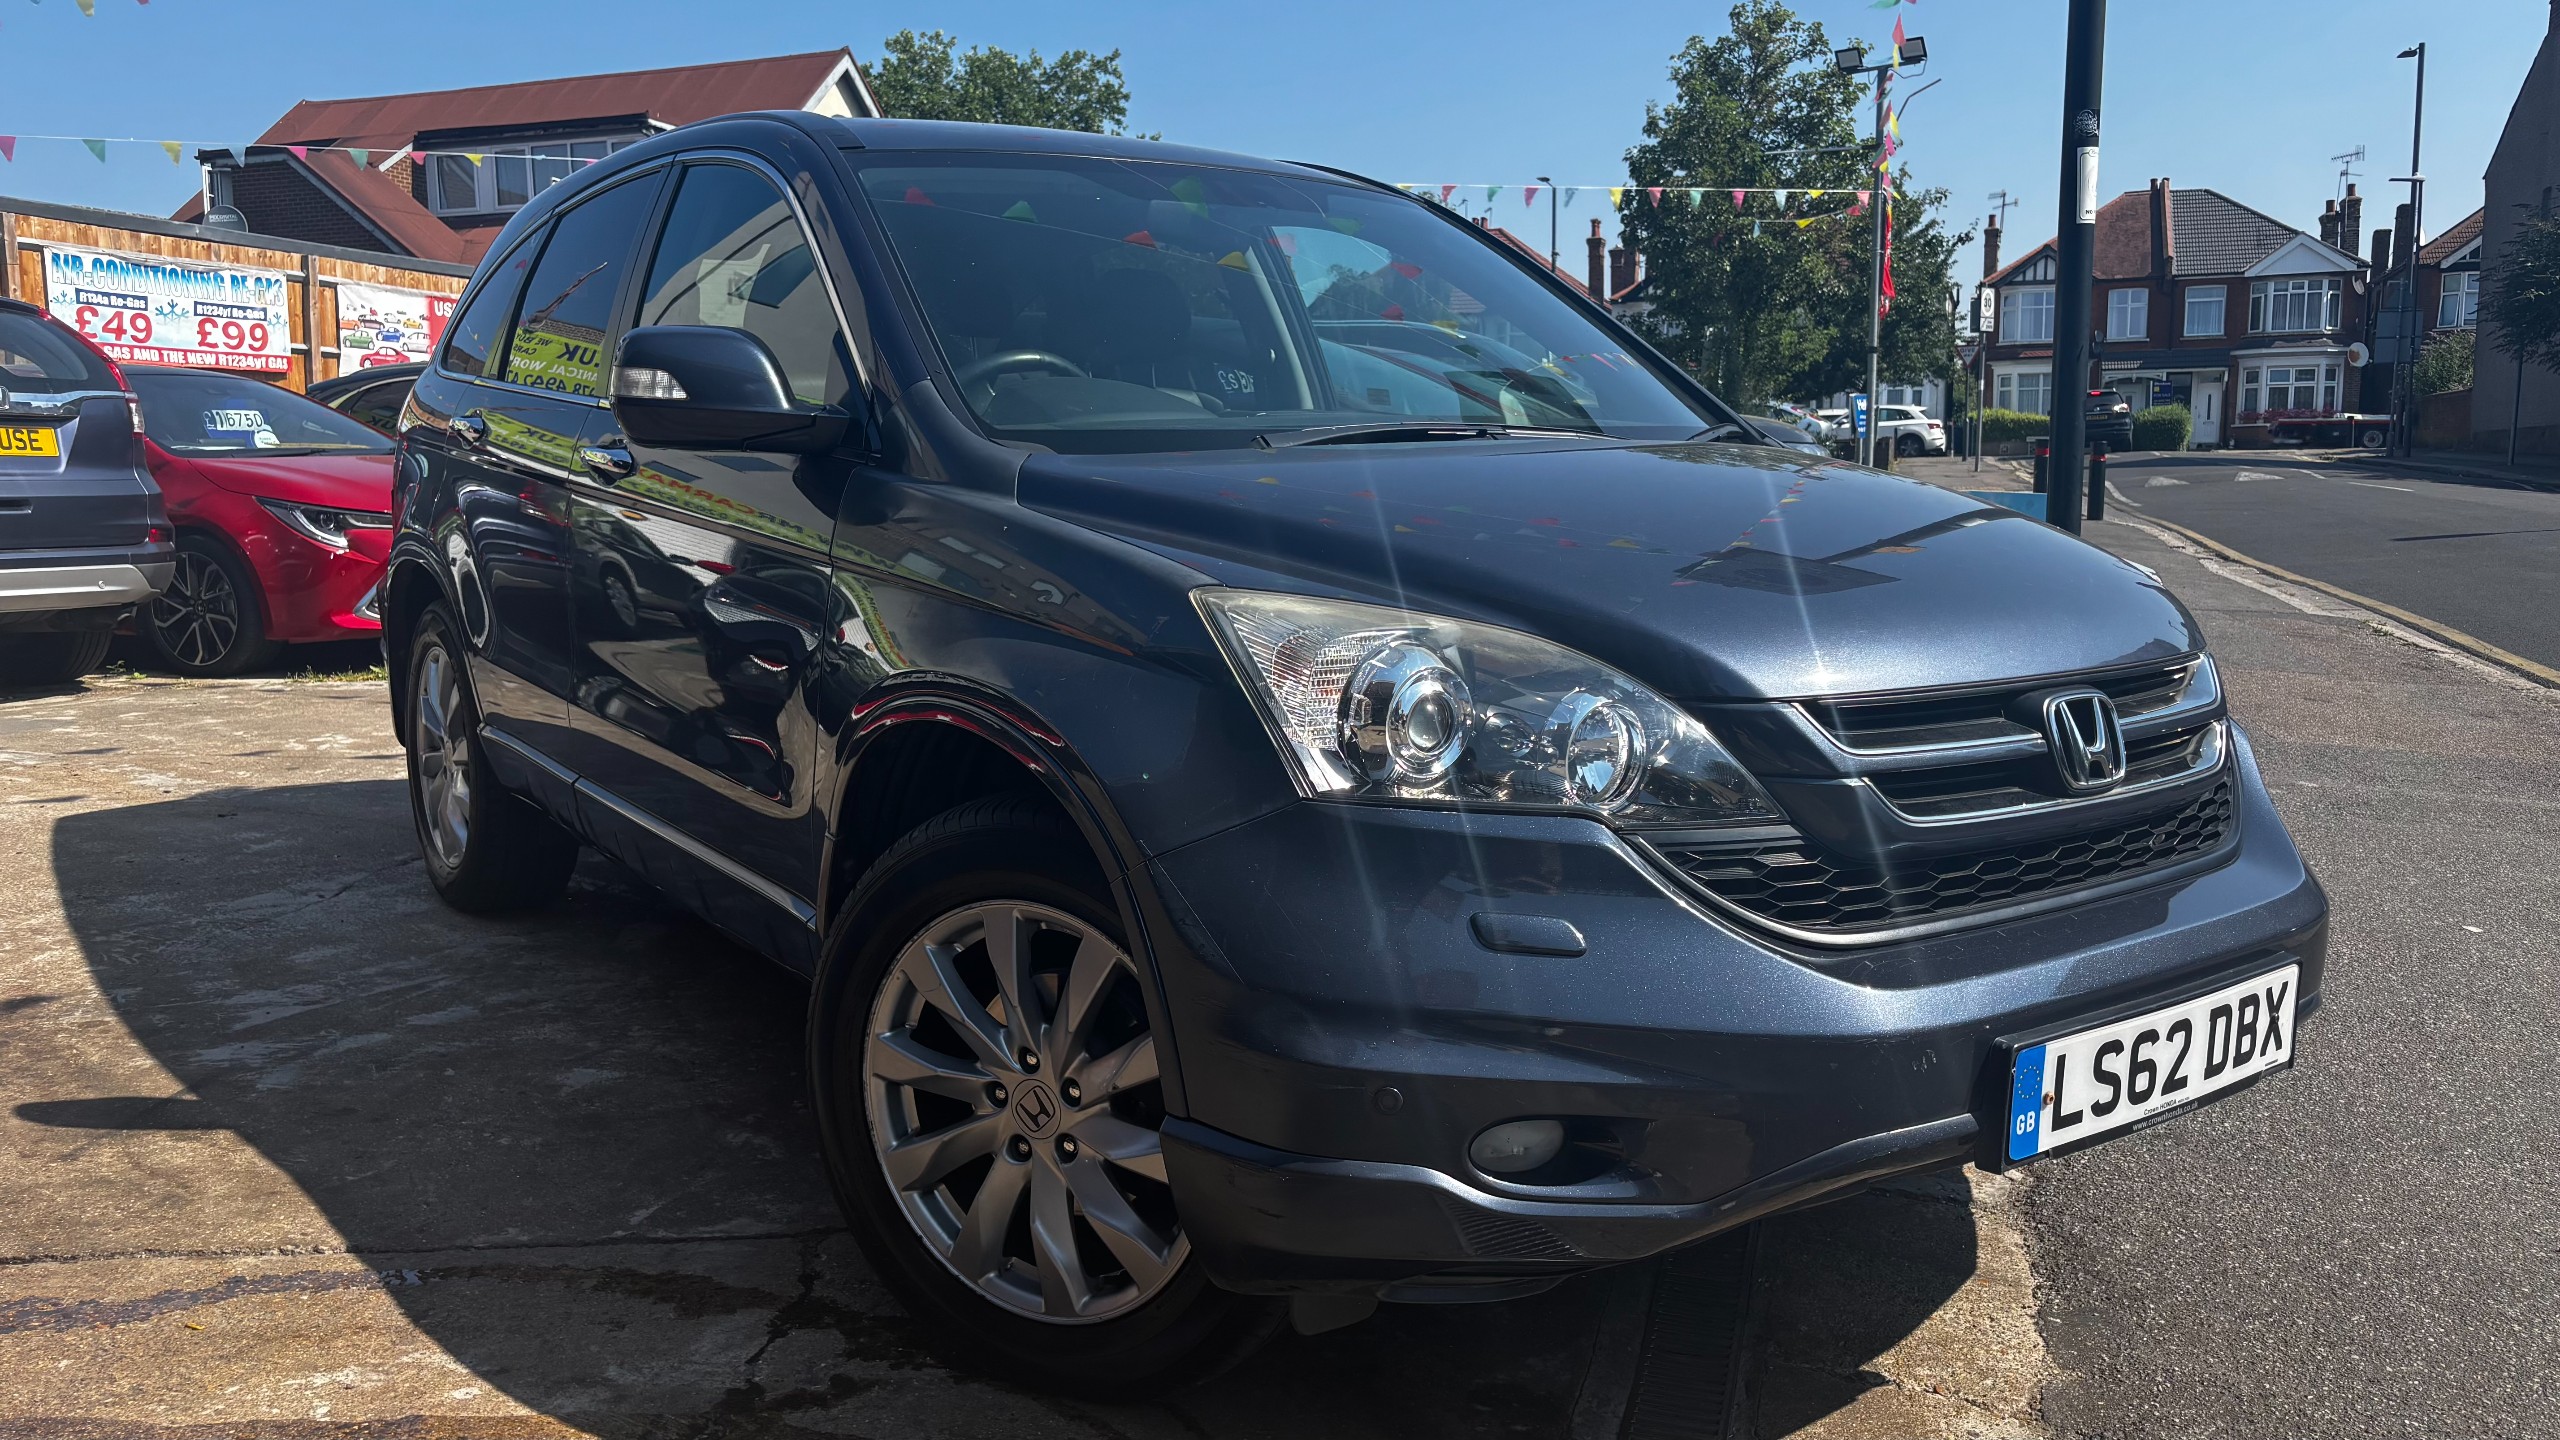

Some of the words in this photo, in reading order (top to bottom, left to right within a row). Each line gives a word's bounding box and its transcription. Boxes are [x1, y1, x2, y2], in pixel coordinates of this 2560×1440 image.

[52, 252, 227, 302] AIR-CONDITIONING
[230, 274, 285, 307] RE-GAS
[75, 305, 152, 343] £49
[433, 300, 456, 318] US
[197, 317, 269, 352] £99
[133, 347, 160, 362] AND
[161, 350, 186, 364] THE
[187, 352, 216, 365] NEW
[268, 356, 289, 370] GAS
[2051, 1017, 2193, 1132] LS62
[2203, 980, 2289, 1080] DBX
[2015, 1109, 2036, 1136] GB
[2132, 1100, 2199, 1131] www.crownhonda.co.uk
[2143, 1105, 2159, 1116] Crown
[2159, 1098, 2177, 1110] HONDA
